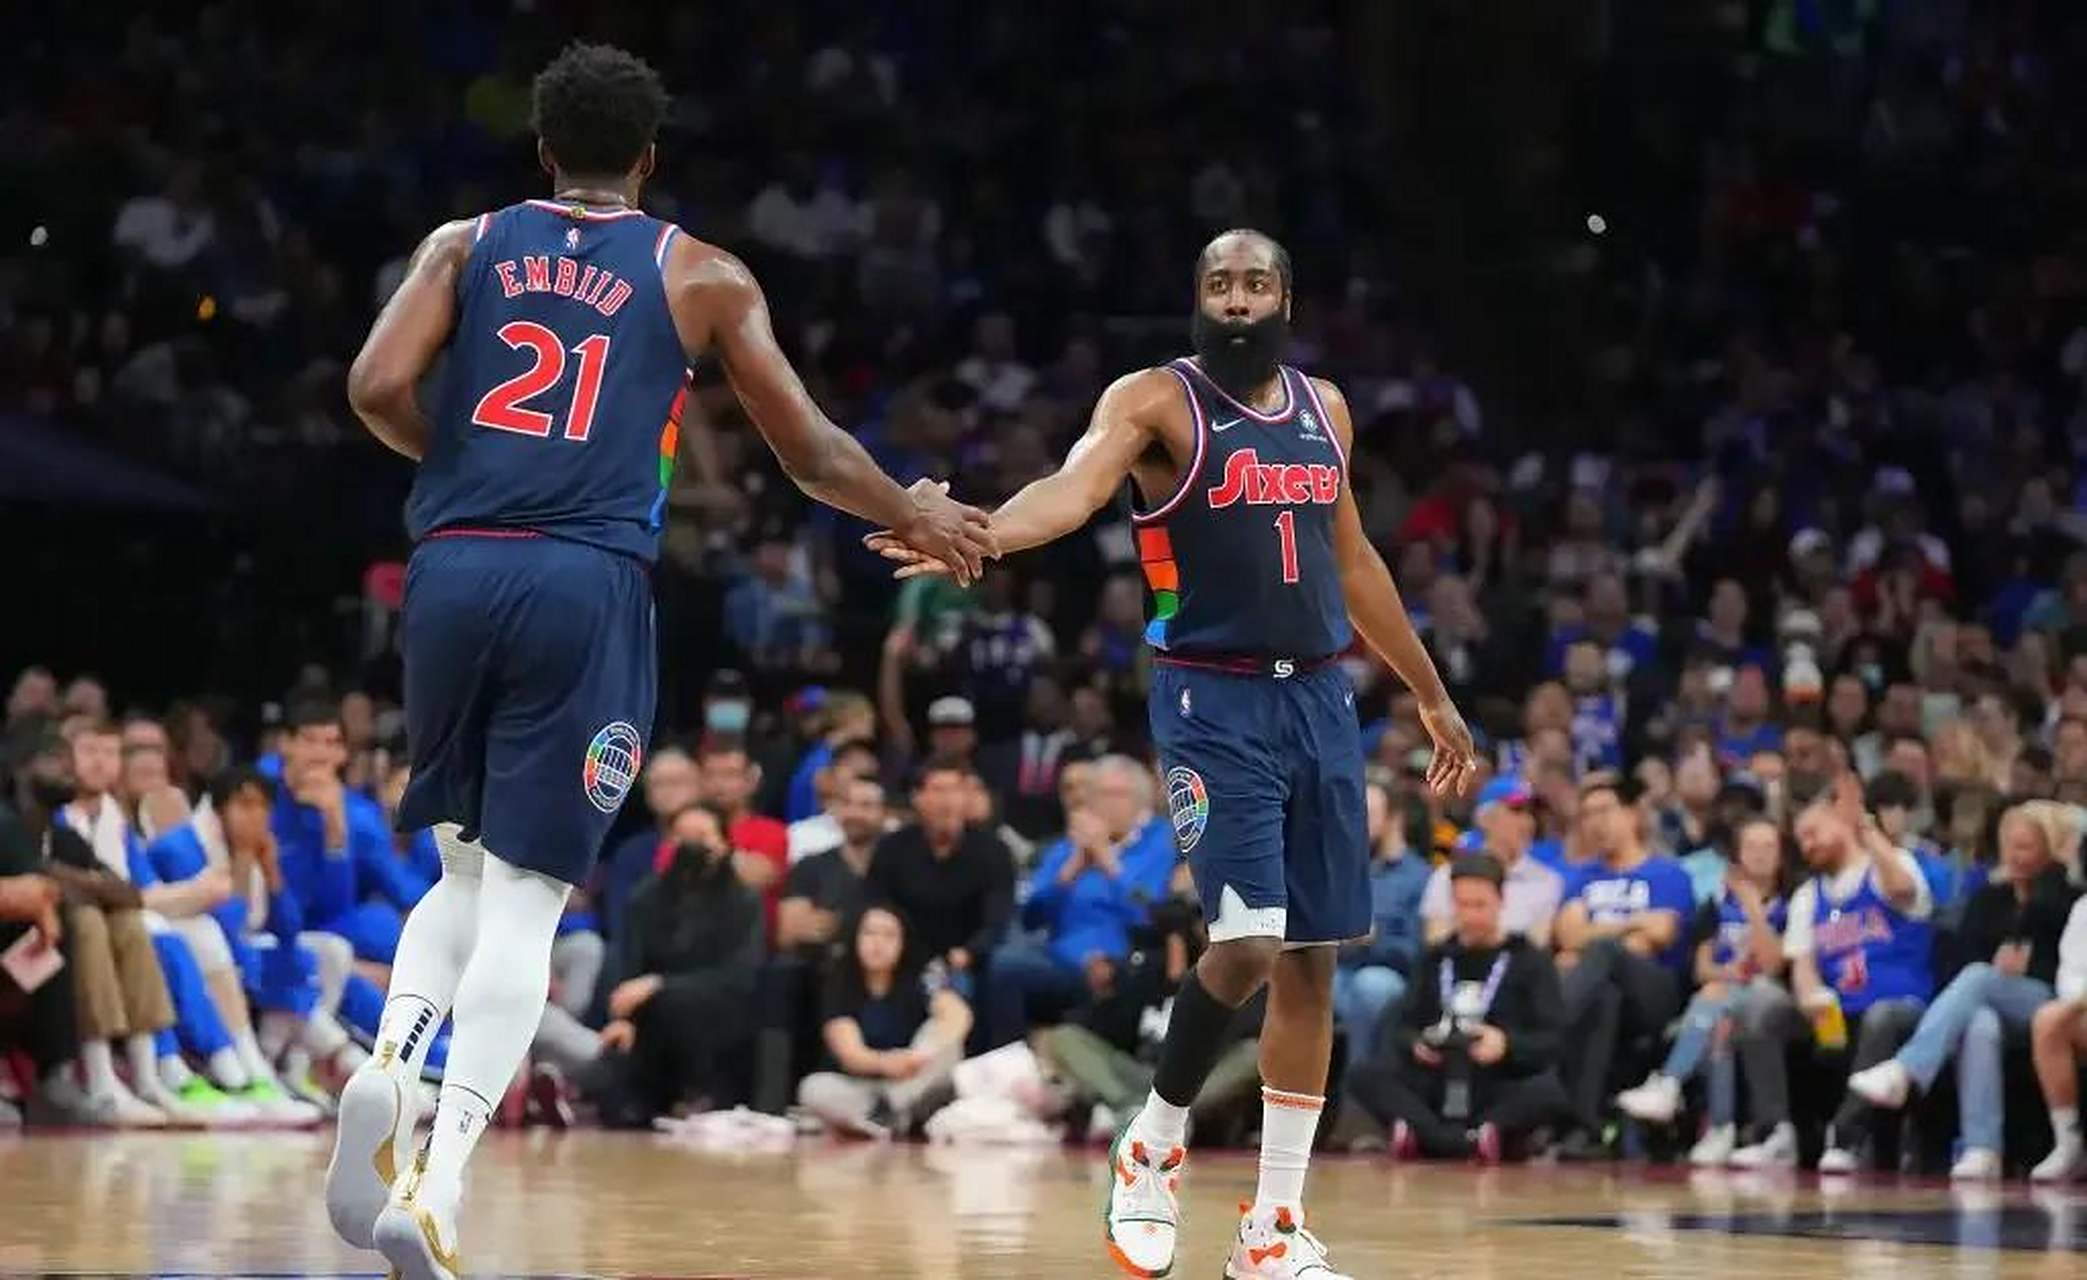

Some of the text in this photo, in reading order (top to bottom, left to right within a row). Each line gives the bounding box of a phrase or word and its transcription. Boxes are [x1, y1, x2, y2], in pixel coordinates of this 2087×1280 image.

[495, 256, 633, 316] EMBIID
[472, 320, 610, 440] 21
[1274, 511, 1299, 583] 1
